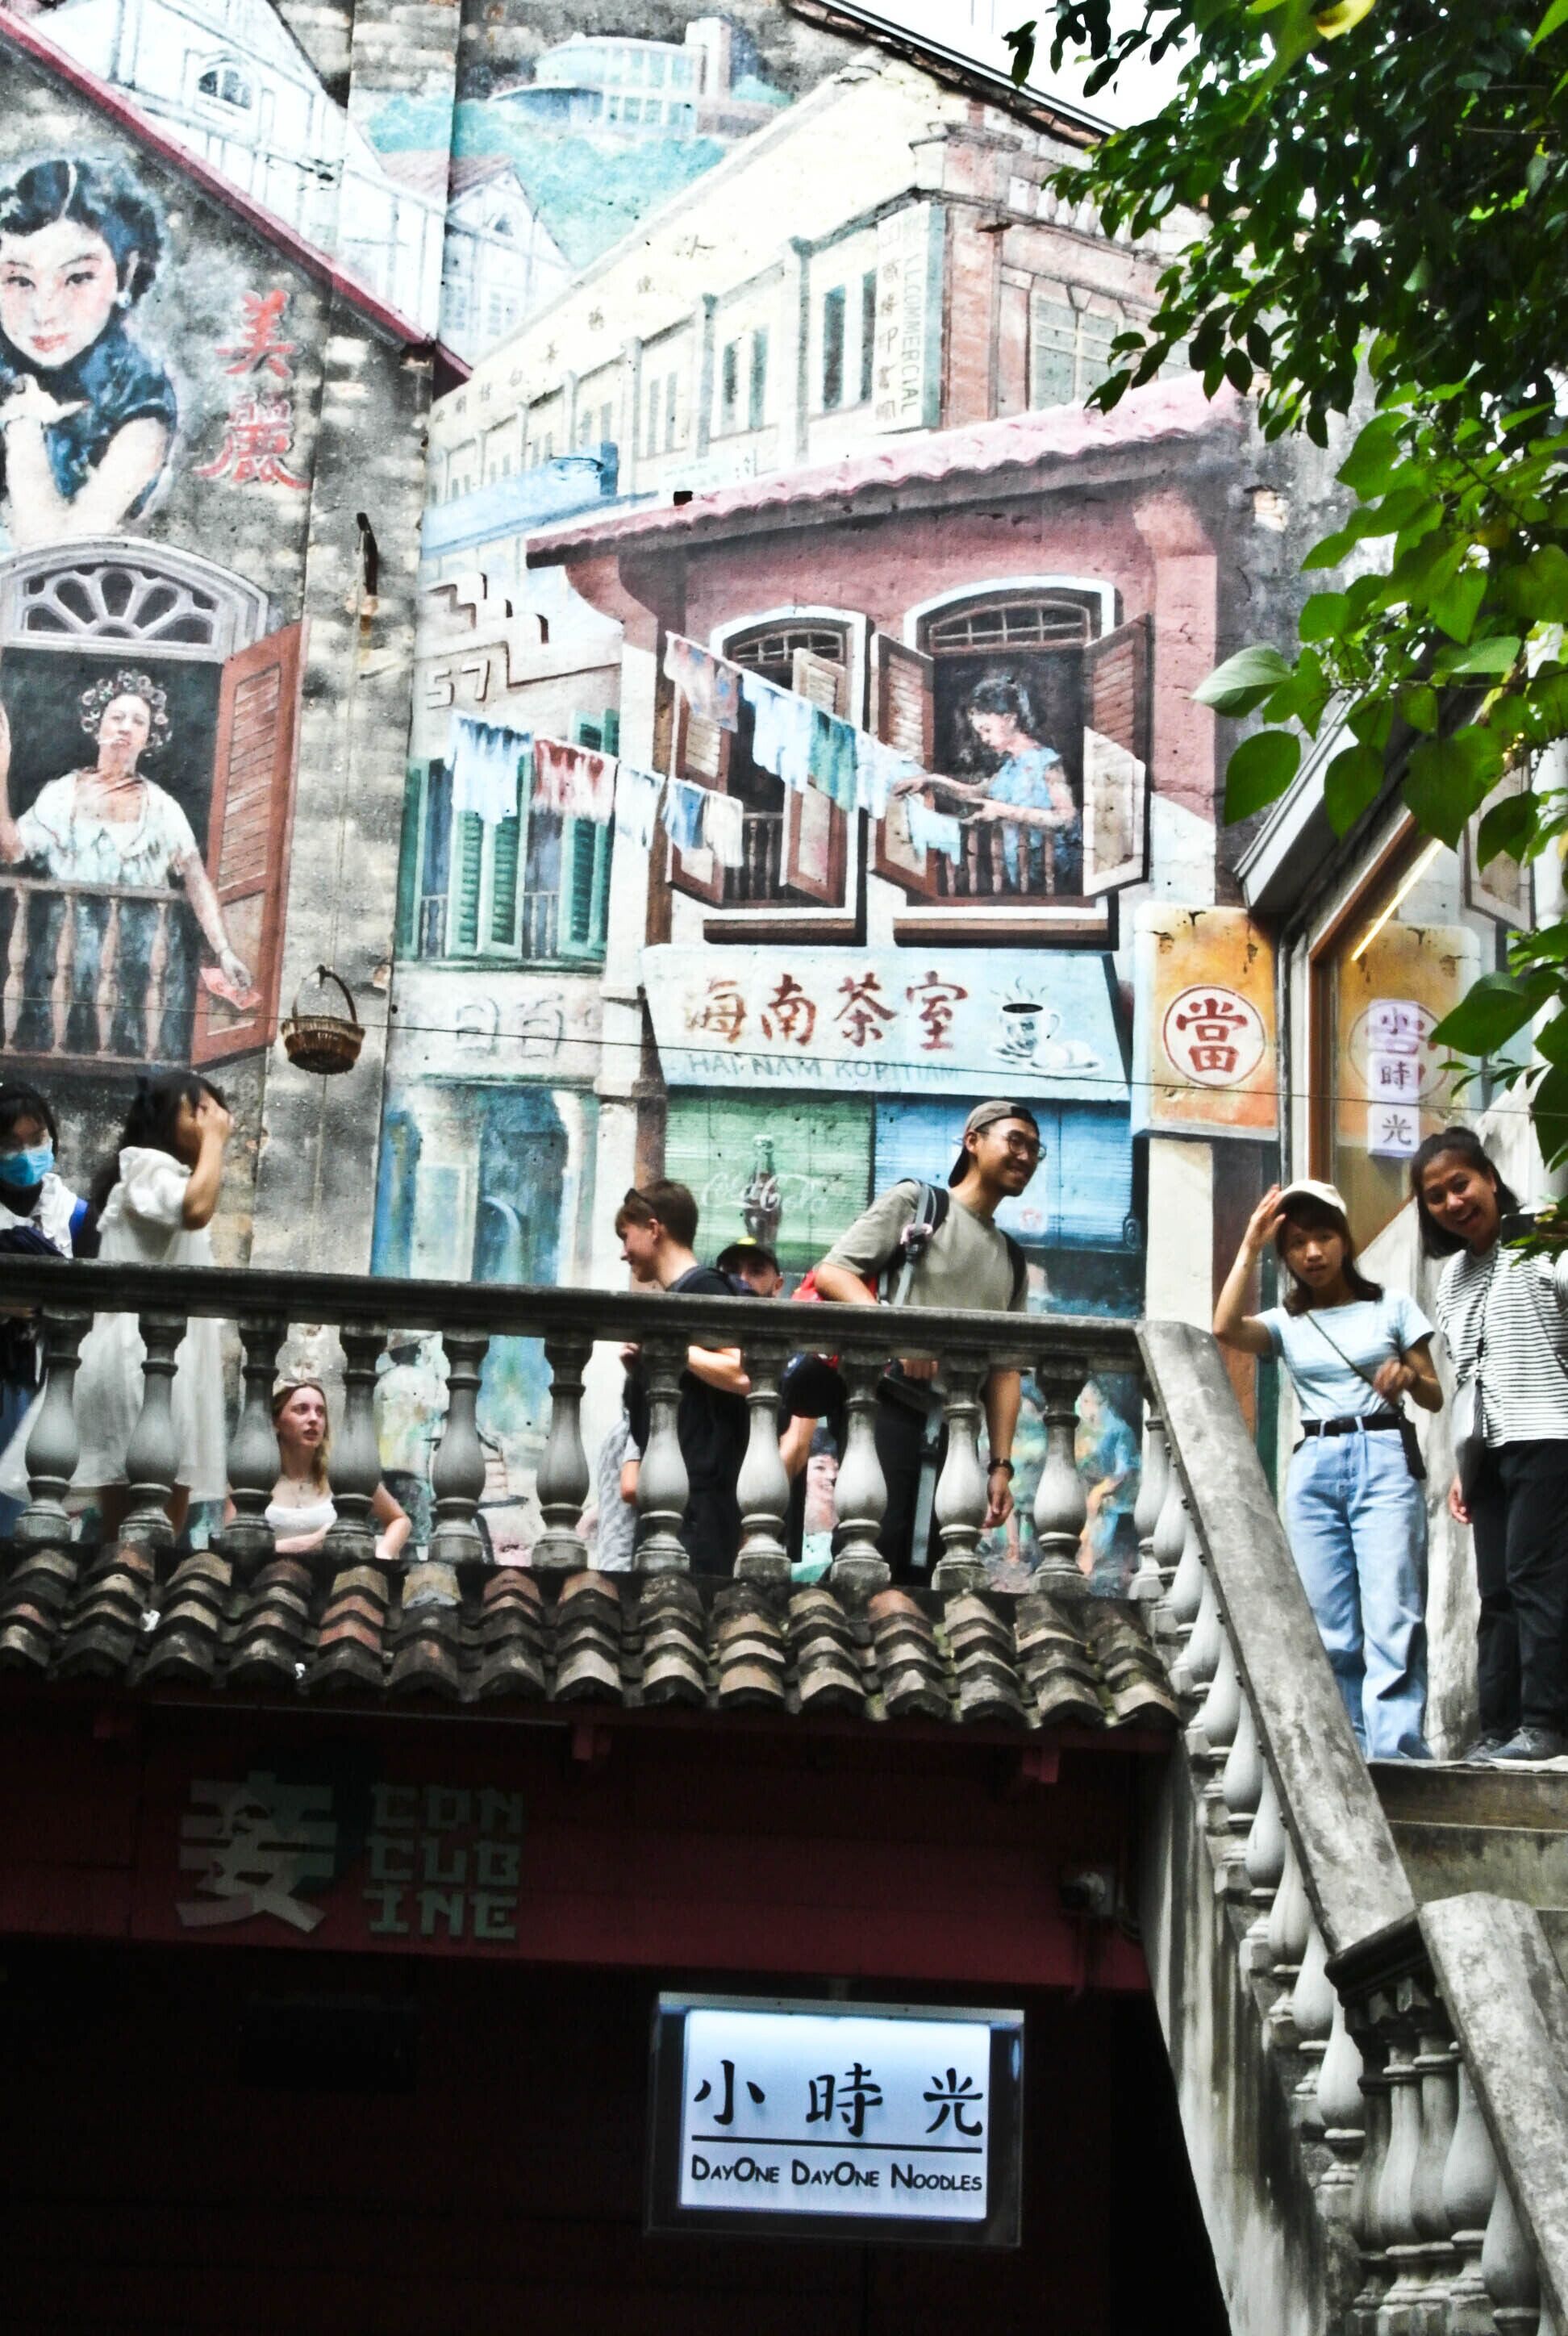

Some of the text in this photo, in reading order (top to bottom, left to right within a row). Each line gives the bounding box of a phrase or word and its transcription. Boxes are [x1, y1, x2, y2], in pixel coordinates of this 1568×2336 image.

[193, 289, 312, 489] 美麗
[425, 659, 491, 710] 57
[683, 970, 968, 1050] 海南茶室
[1176, 997, 1248, 1073] 當
[1380, 1006, 1412, 1145] 小時光
[371, 1784, 523, 1833] CON
[365, 1888, 518, 1938] INE
[694, 2059, 983, 2138] 小時光
